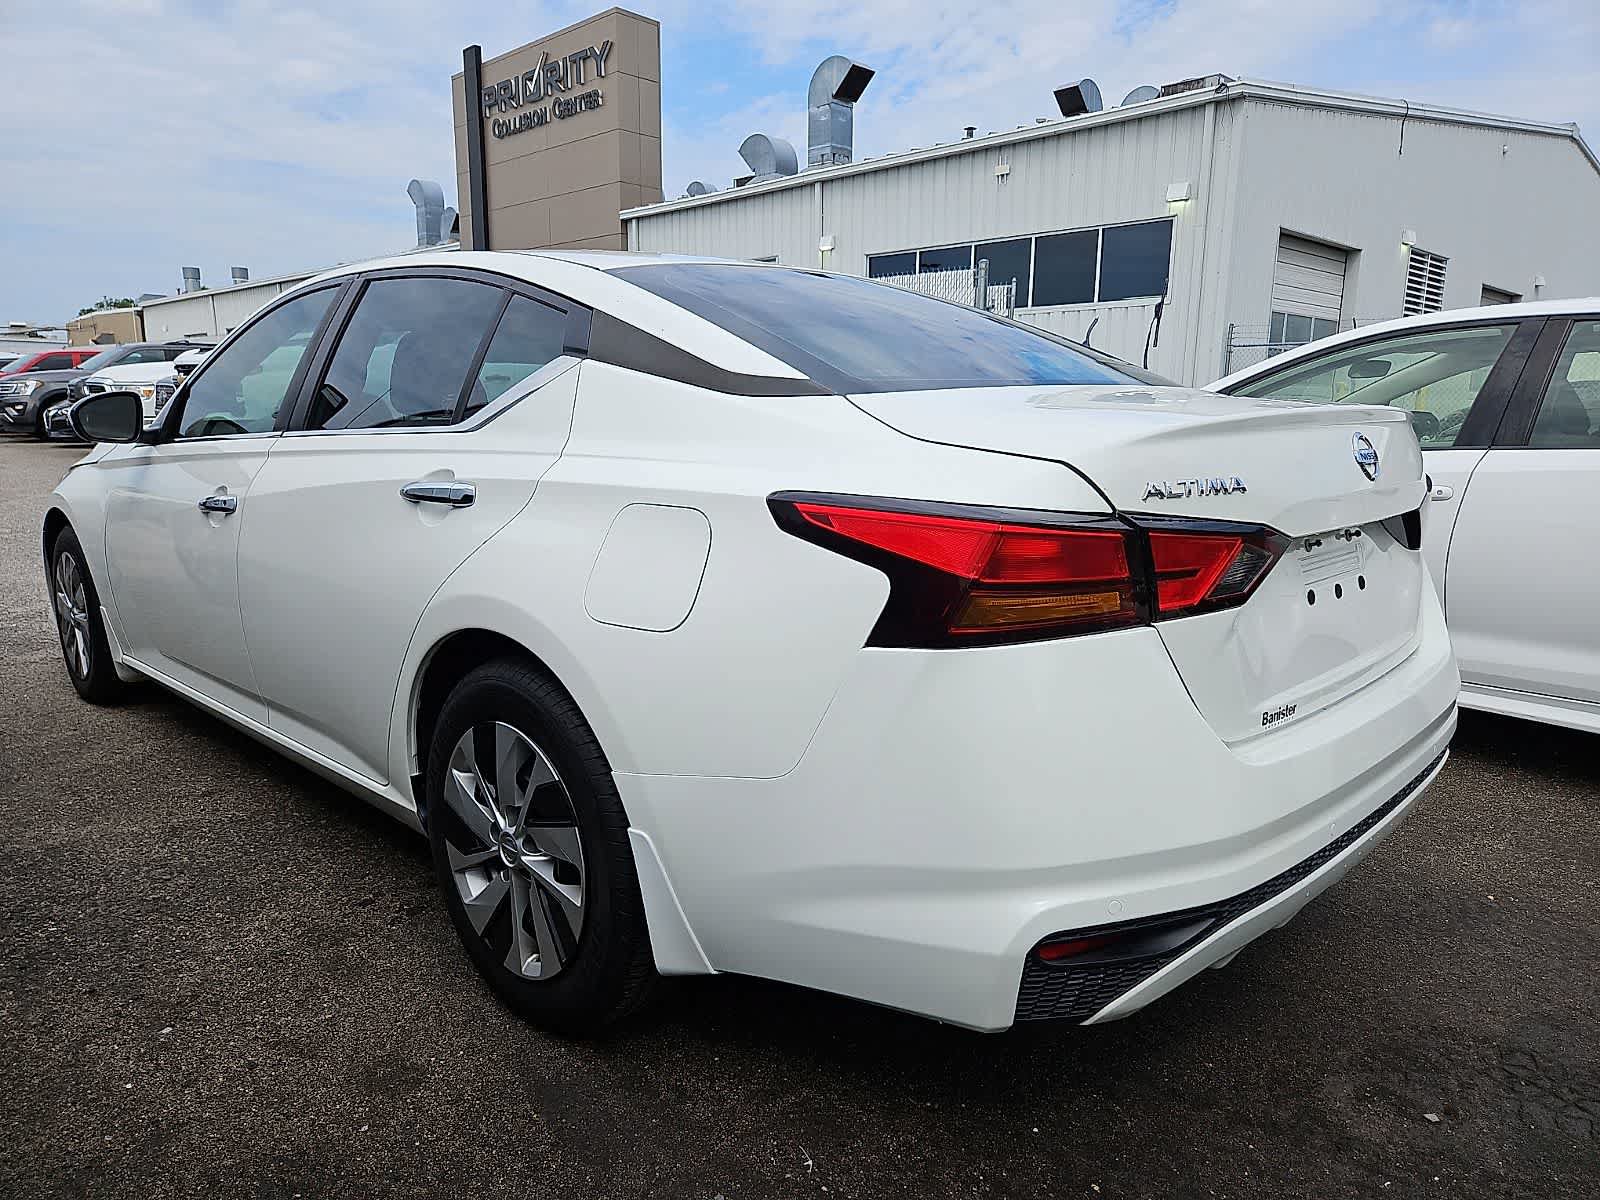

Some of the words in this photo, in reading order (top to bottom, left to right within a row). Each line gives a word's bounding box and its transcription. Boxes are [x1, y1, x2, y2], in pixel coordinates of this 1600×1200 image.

[482, 39, 613, 119] PRIORITY
[492, 106, 551, 139] COLLISION
[552, 89, 603, 120] CENTER
[1141, 475, 1248, 502] ALTIMA
[1262, 704, 1297, 726] Banister
